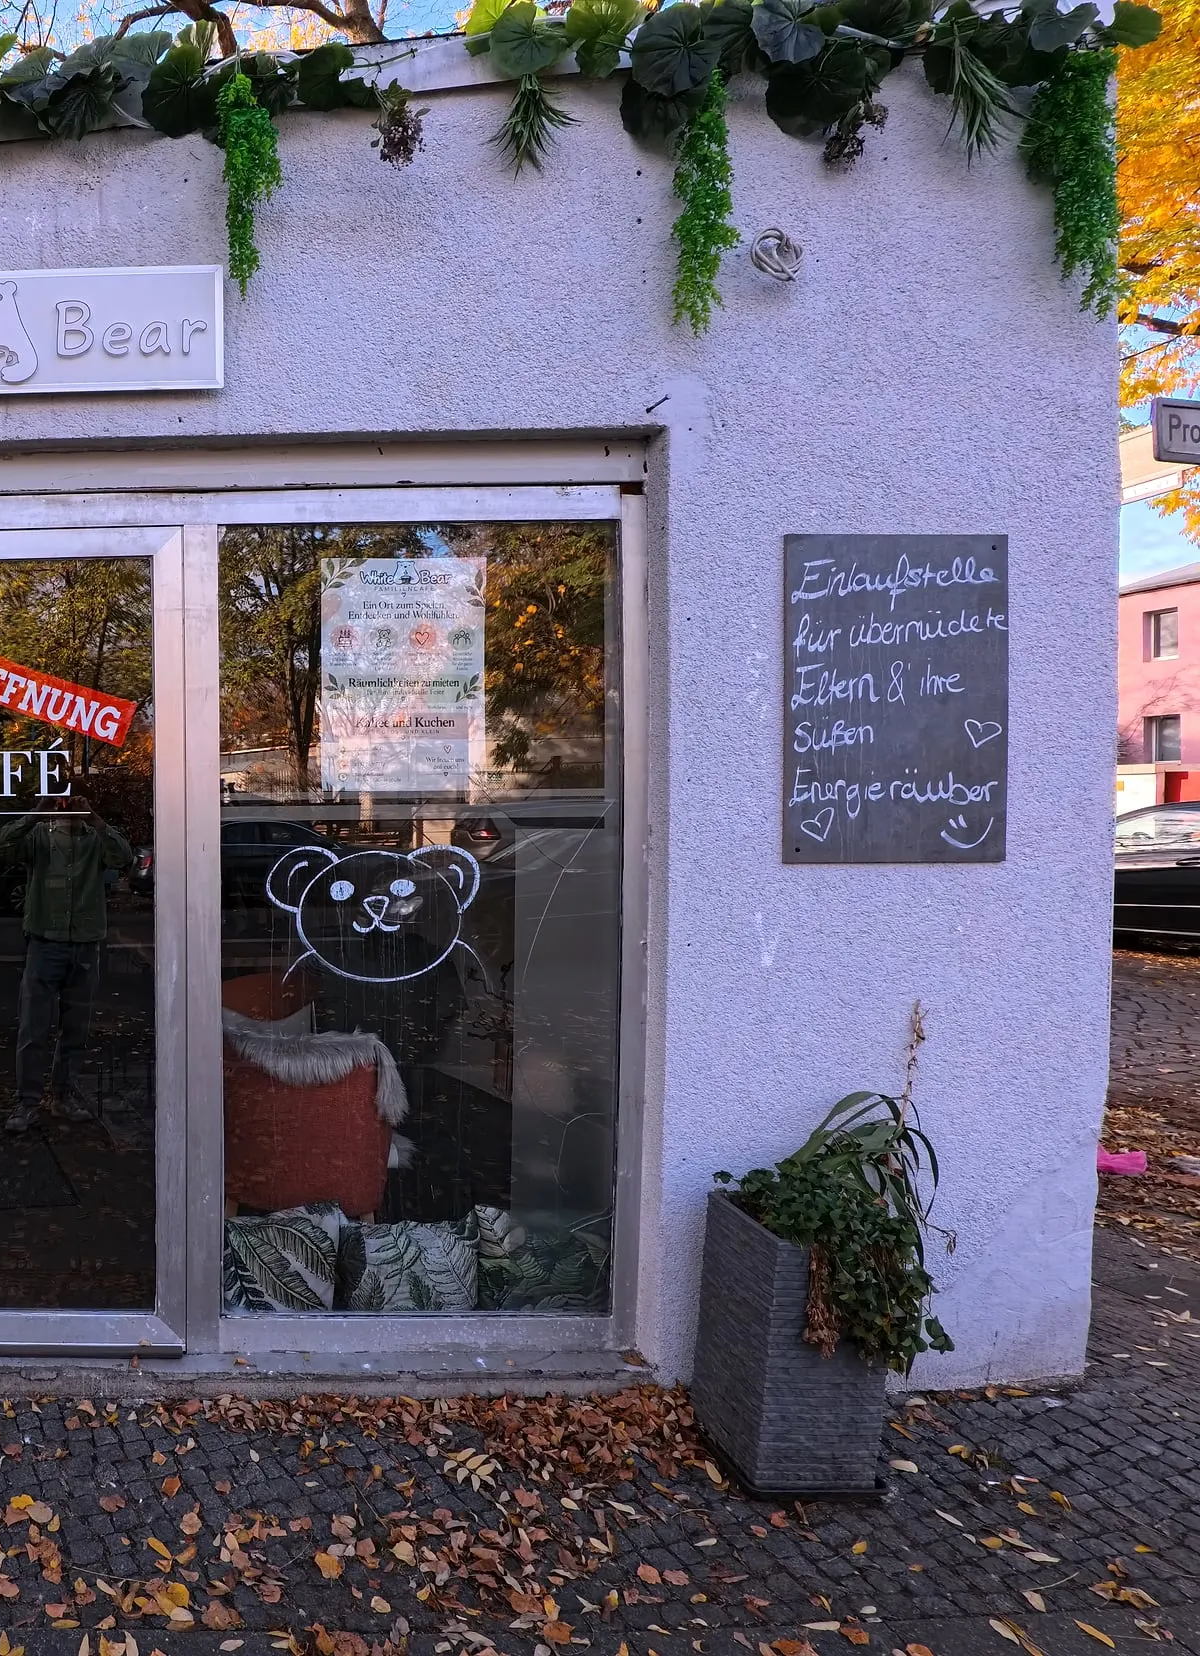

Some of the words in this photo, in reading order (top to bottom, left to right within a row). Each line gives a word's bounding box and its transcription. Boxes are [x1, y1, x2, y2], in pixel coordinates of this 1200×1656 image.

[55, 300, 208, 359] Bear
[360, 570, 394, 585] White
[419, 570, 452, 585] Bear
[363, 601, 377, 610] Ein
[379, 601, 393, 610] Ort
[394, 610, 410, 620] und
[793, 613, 841, 657] für
[850, 608, 1008, 647] übermüdete
[348, 677, 419, 688] Räumlichkeiten
[421, 680, 431, 688] zu
[432, 677, 460, 688] mieten
[791, 663, 880, 710] Eltern
[919, 658, 965, 697] ihre
[392, 717, 412, 728] und
[415, 717, 455, 728] Kuchen
[789, 766, 999, 819] Energieräuber
